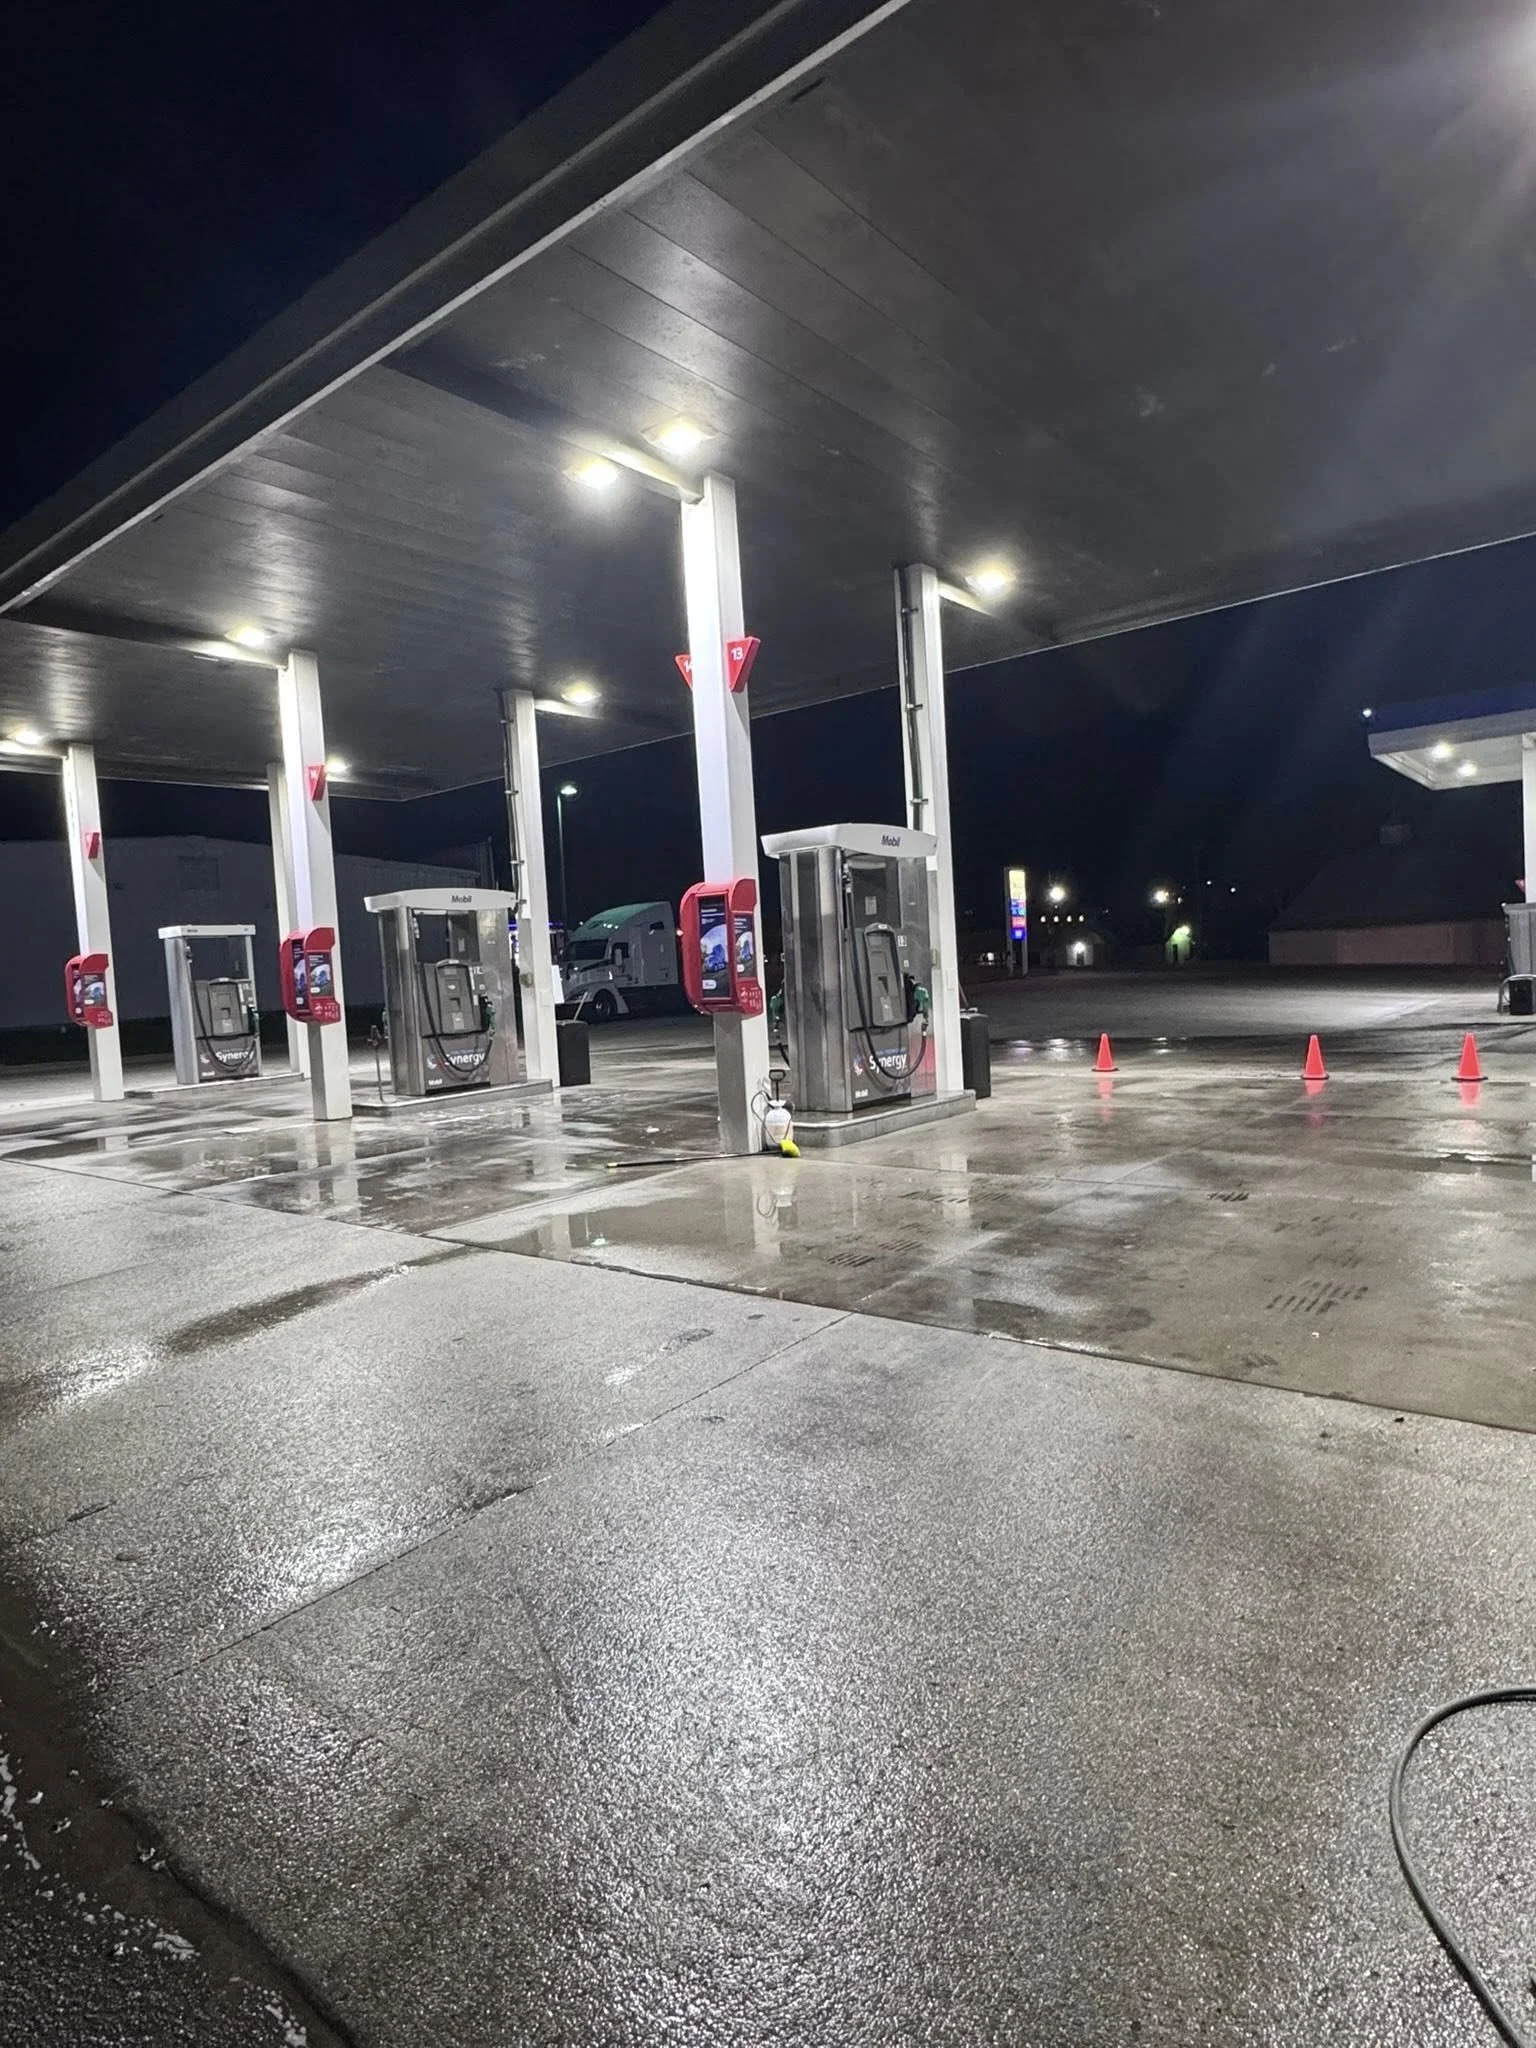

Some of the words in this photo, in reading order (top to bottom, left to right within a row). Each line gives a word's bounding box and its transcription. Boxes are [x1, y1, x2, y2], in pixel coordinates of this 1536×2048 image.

[731, 646, 743, 661] 13
[881, 835, 901, 847] Mobil
[451, 895, 472, 903] Mobil
